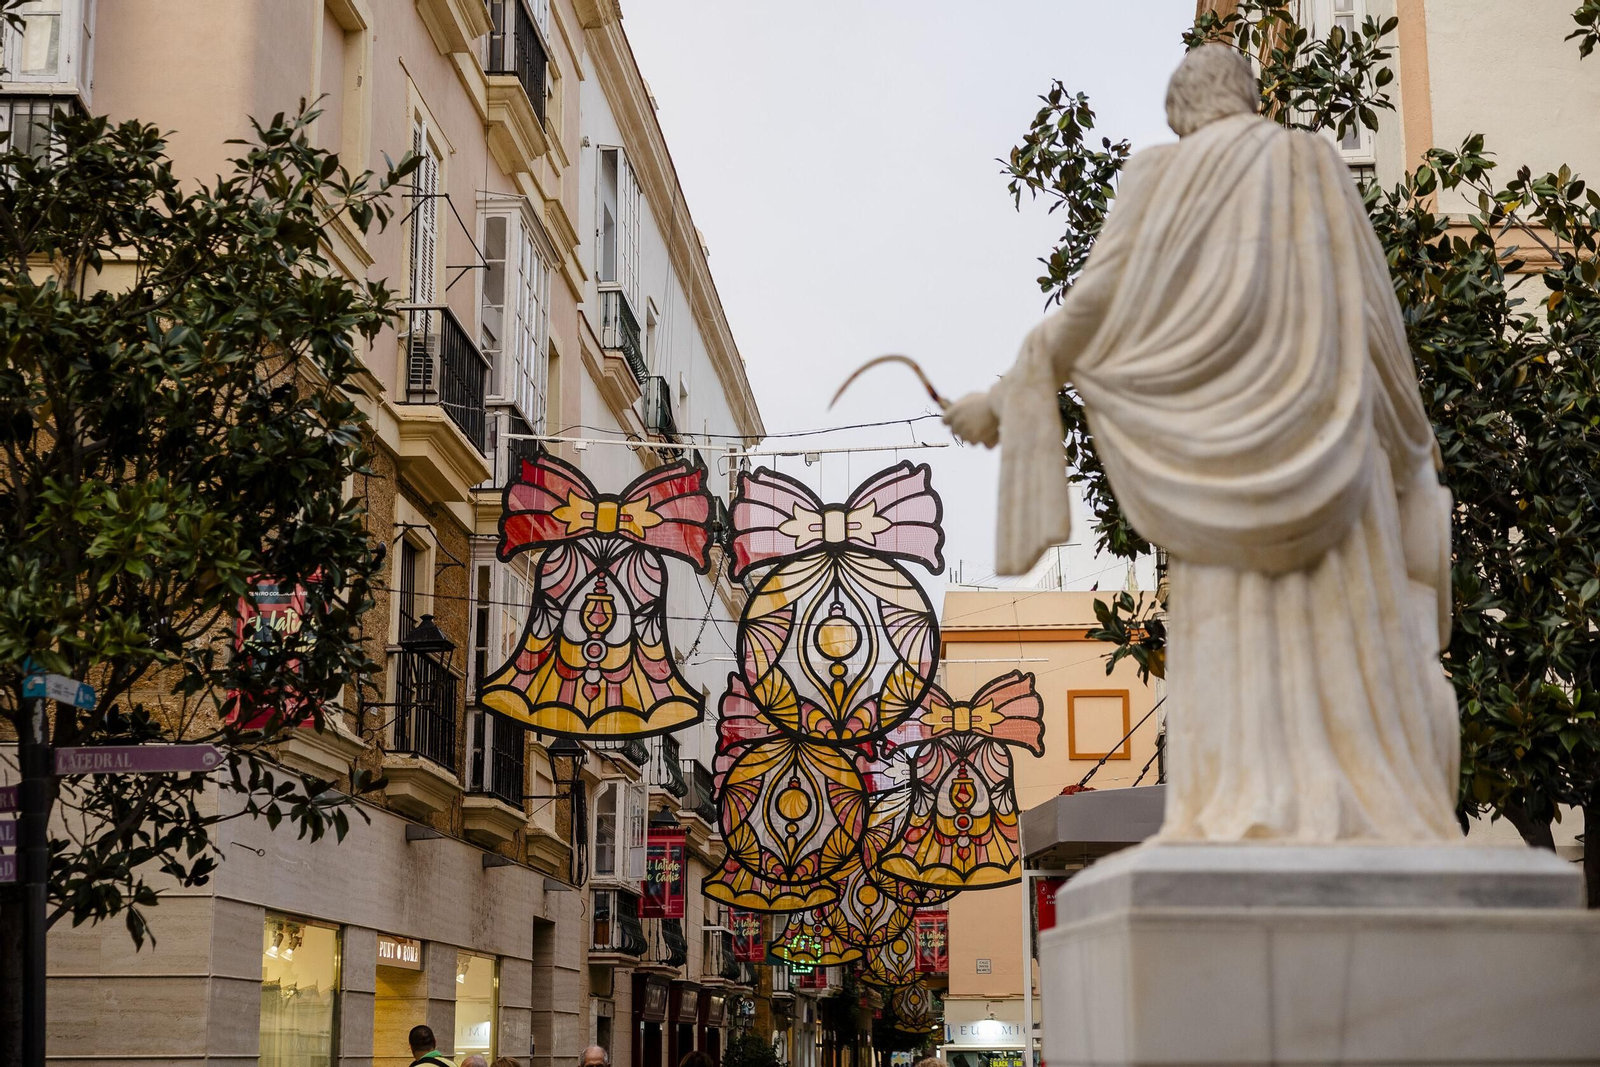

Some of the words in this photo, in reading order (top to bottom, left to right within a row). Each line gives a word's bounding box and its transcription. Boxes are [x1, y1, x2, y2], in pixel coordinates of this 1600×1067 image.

[58, 752, 133, 770] CATEDRAL
[654, 857, 681, 871] latido
[379, 941, 396, 959] PUNT
[402, 945, 418, 962] ROMA
